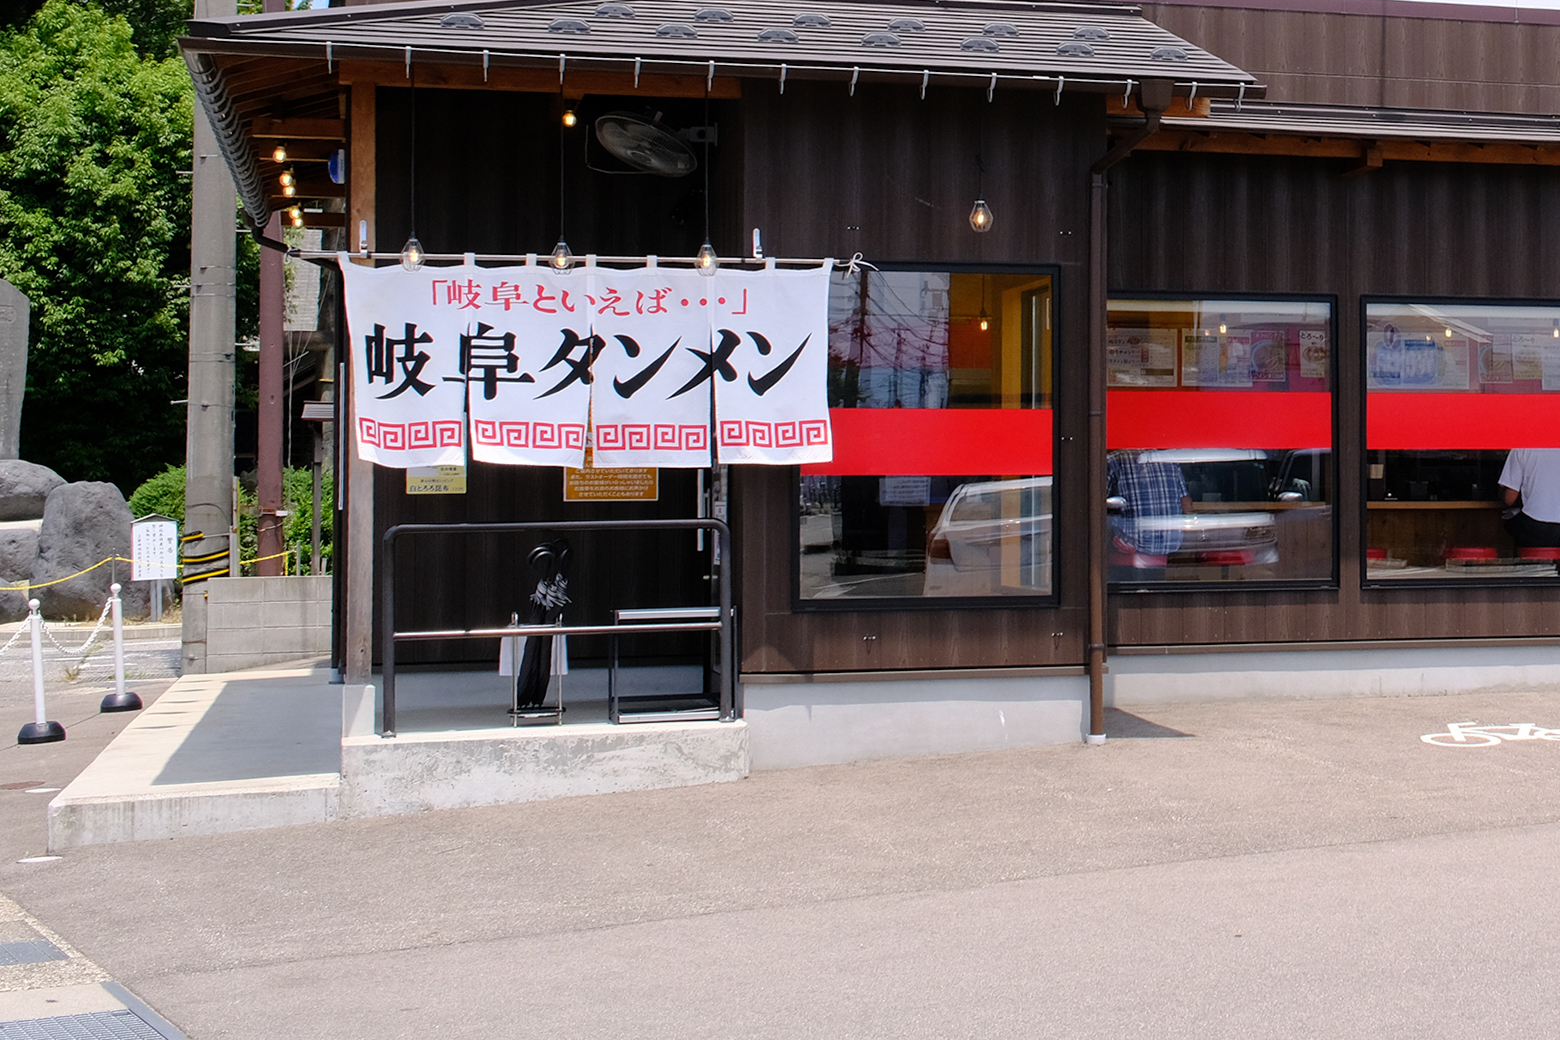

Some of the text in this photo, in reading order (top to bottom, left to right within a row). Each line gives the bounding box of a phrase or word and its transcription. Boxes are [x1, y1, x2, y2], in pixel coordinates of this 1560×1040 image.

[364, 321, 813, 402] 岐阜タンメン
